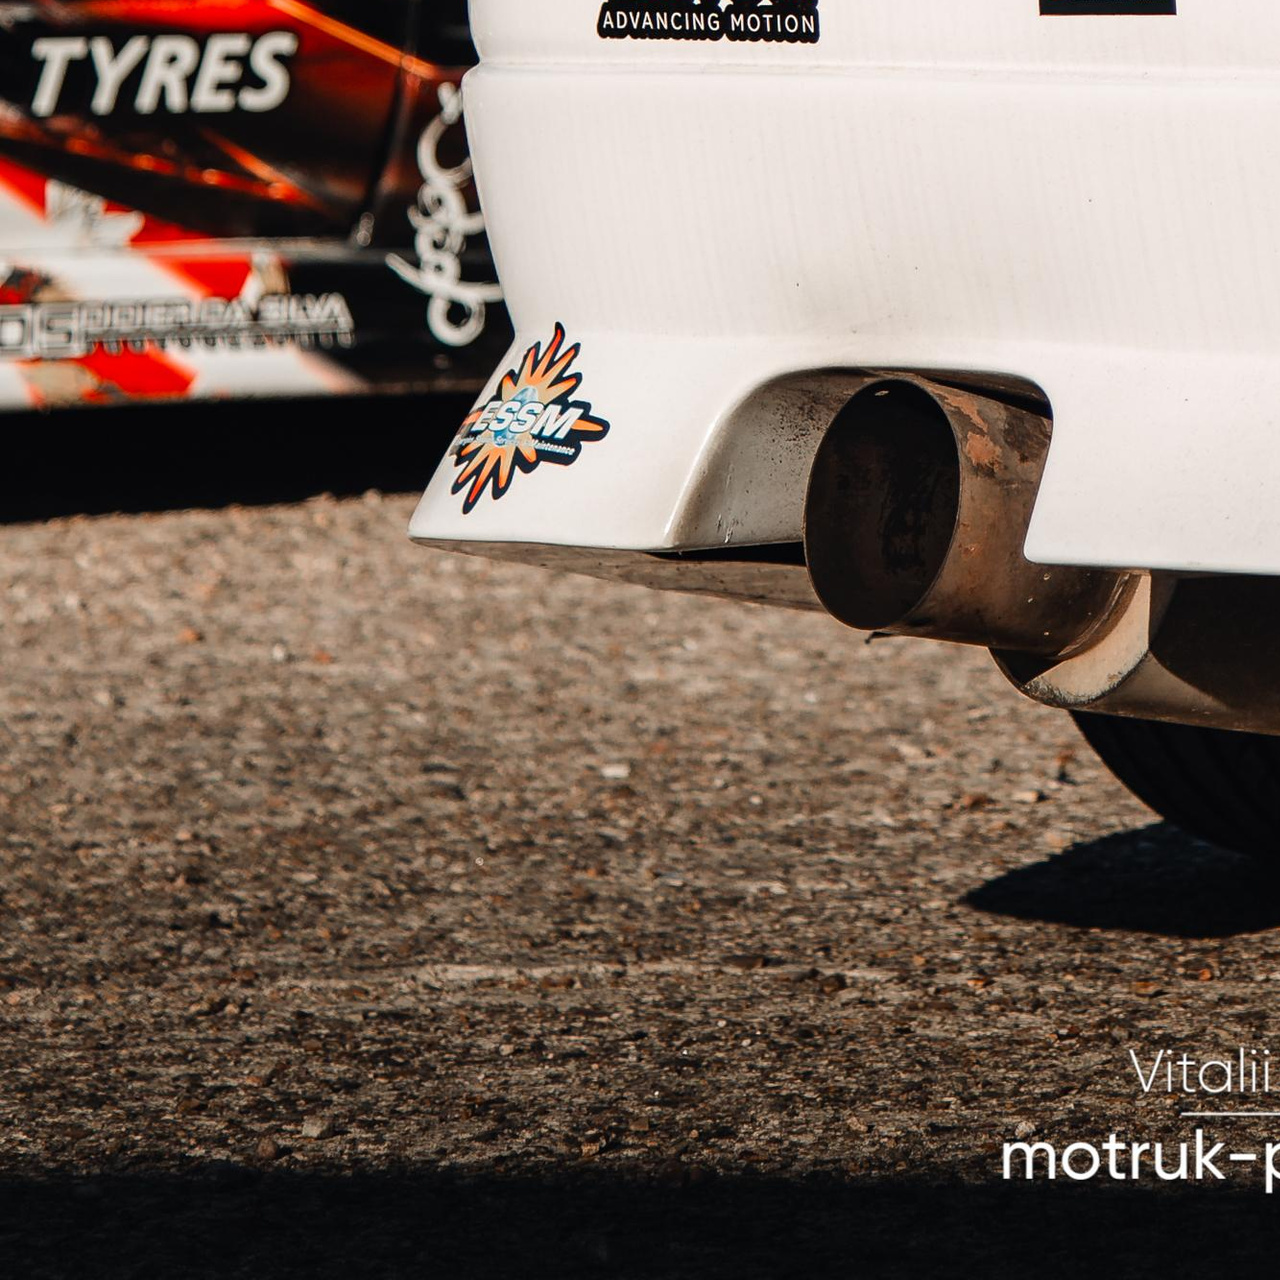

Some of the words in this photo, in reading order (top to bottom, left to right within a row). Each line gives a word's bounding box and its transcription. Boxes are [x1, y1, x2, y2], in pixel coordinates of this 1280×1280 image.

[602, 10, 720, 31] ADVANCING
[730, 13, 816, 33] MOTION
[31, 31, 299, 117] TYRES
[471, 400, 584, 438] ESSM
